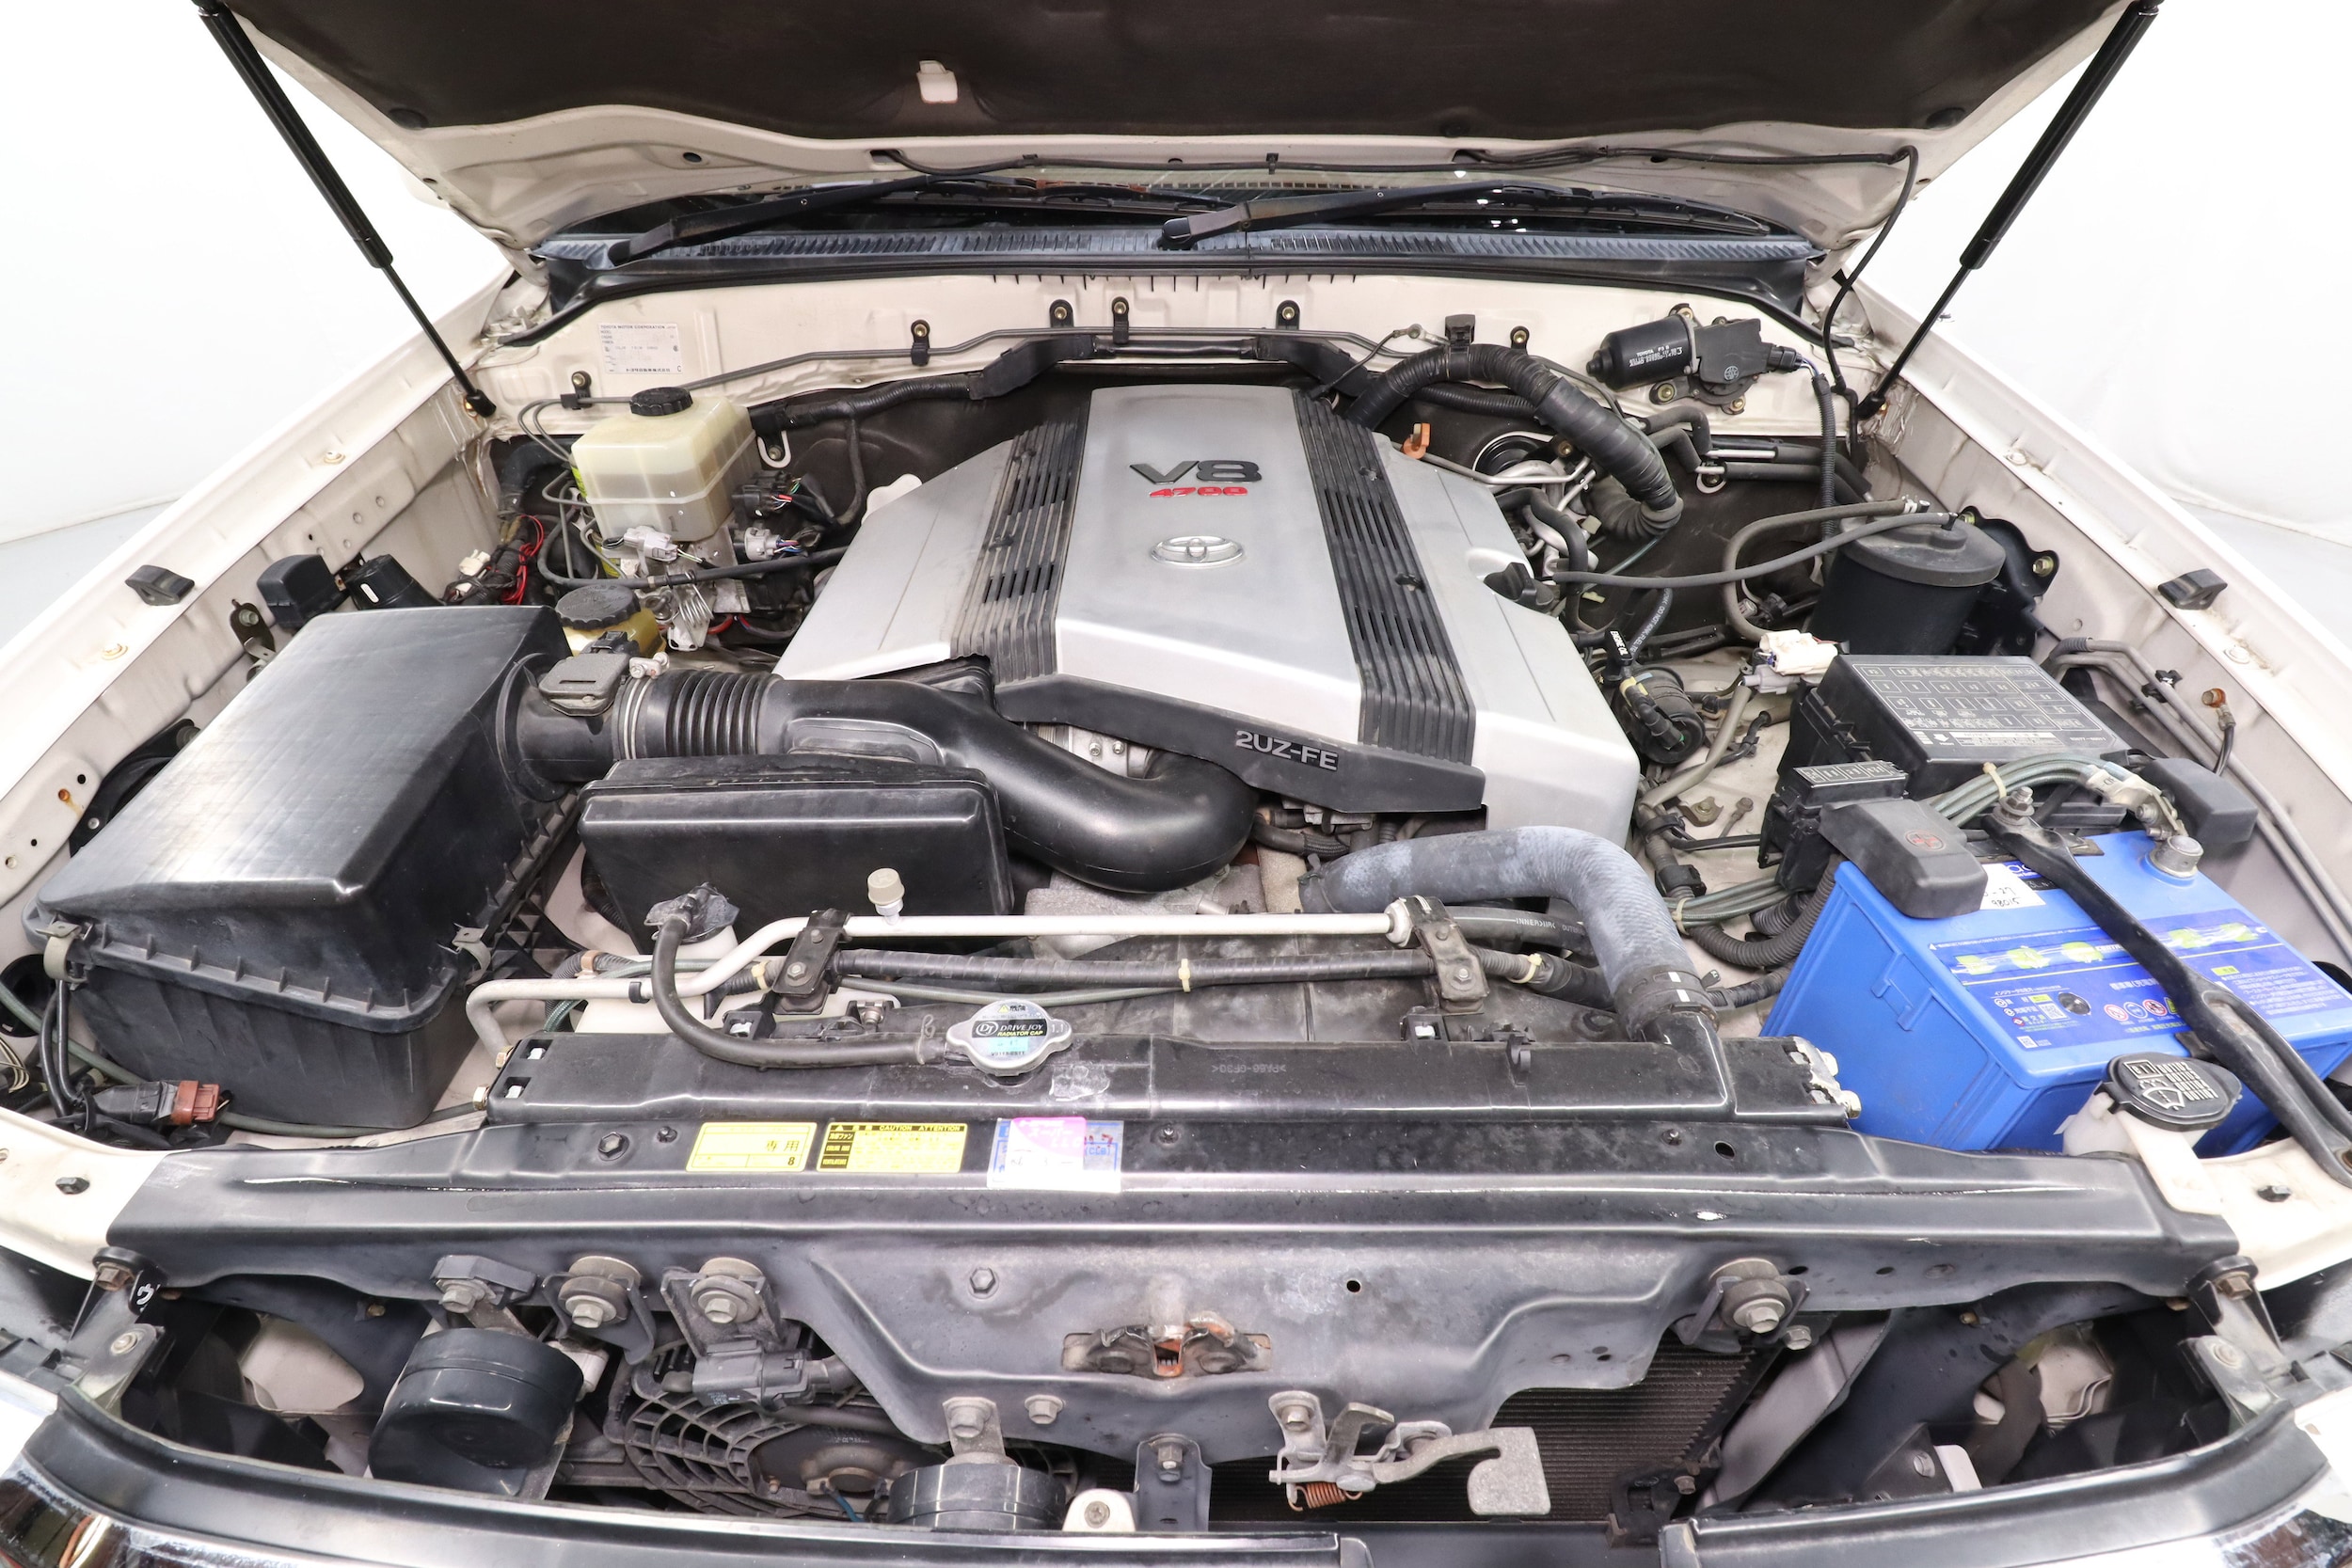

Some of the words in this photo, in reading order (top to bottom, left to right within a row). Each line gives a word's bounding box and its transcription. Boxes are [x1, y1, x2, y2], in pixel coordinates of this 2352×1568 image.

[1130, 460, 1263, 484] V8
[1150, 486, 1248, 499] 4700
[1610, 630, 1626, 647] ENGINE
[1617, 646, 1629, 656] OIL
[1235, 730, 1338, 771] 2UZ-FE
[1052, 1023, 1064, 1033] 1.1
[2131, 1064, 2155, 1074] e11
[2155, 1061, 2192, 1073] 001102
[2165, 1070, 2201, 1083] 001103
[2173, 1079, 2210, 1091] 001104
[2183, 1087, 2219, 1101] 001107
[787, 1156, 796, 1165] 8
